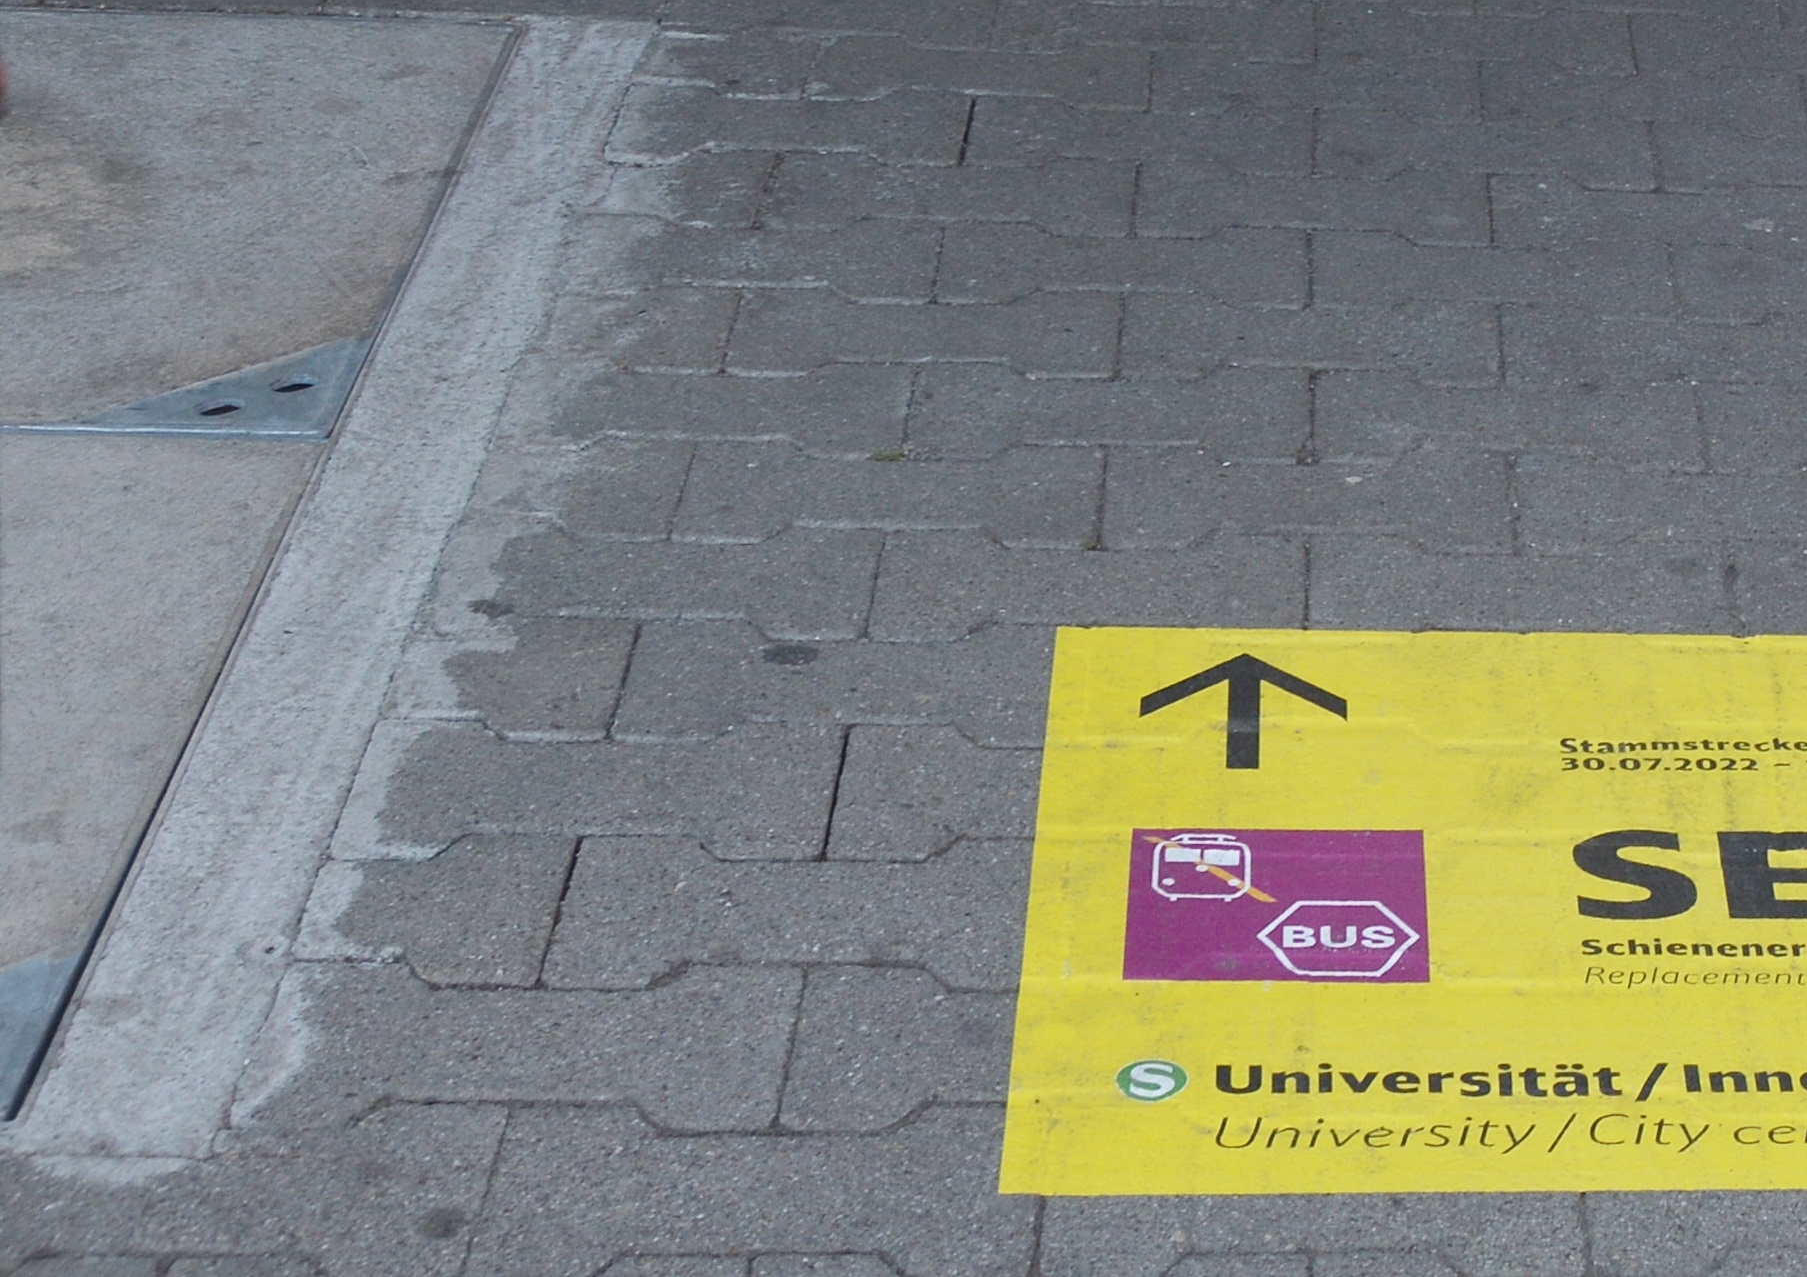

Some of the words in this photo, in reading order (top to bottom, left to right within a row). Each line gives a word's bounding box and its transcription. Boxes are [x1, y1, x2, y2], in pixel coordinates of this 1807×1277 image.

[1560, 756, 1760, 773] 30.07.2022
[1281, 924, 1396, 949] BUS
[1584, 965, 1807, 990] Replacement
[1214, 1061, 1623, 1098] Universität
[1214, 1113, 1536, 1154] University
[1588, 1111, 1712, 1153] City
